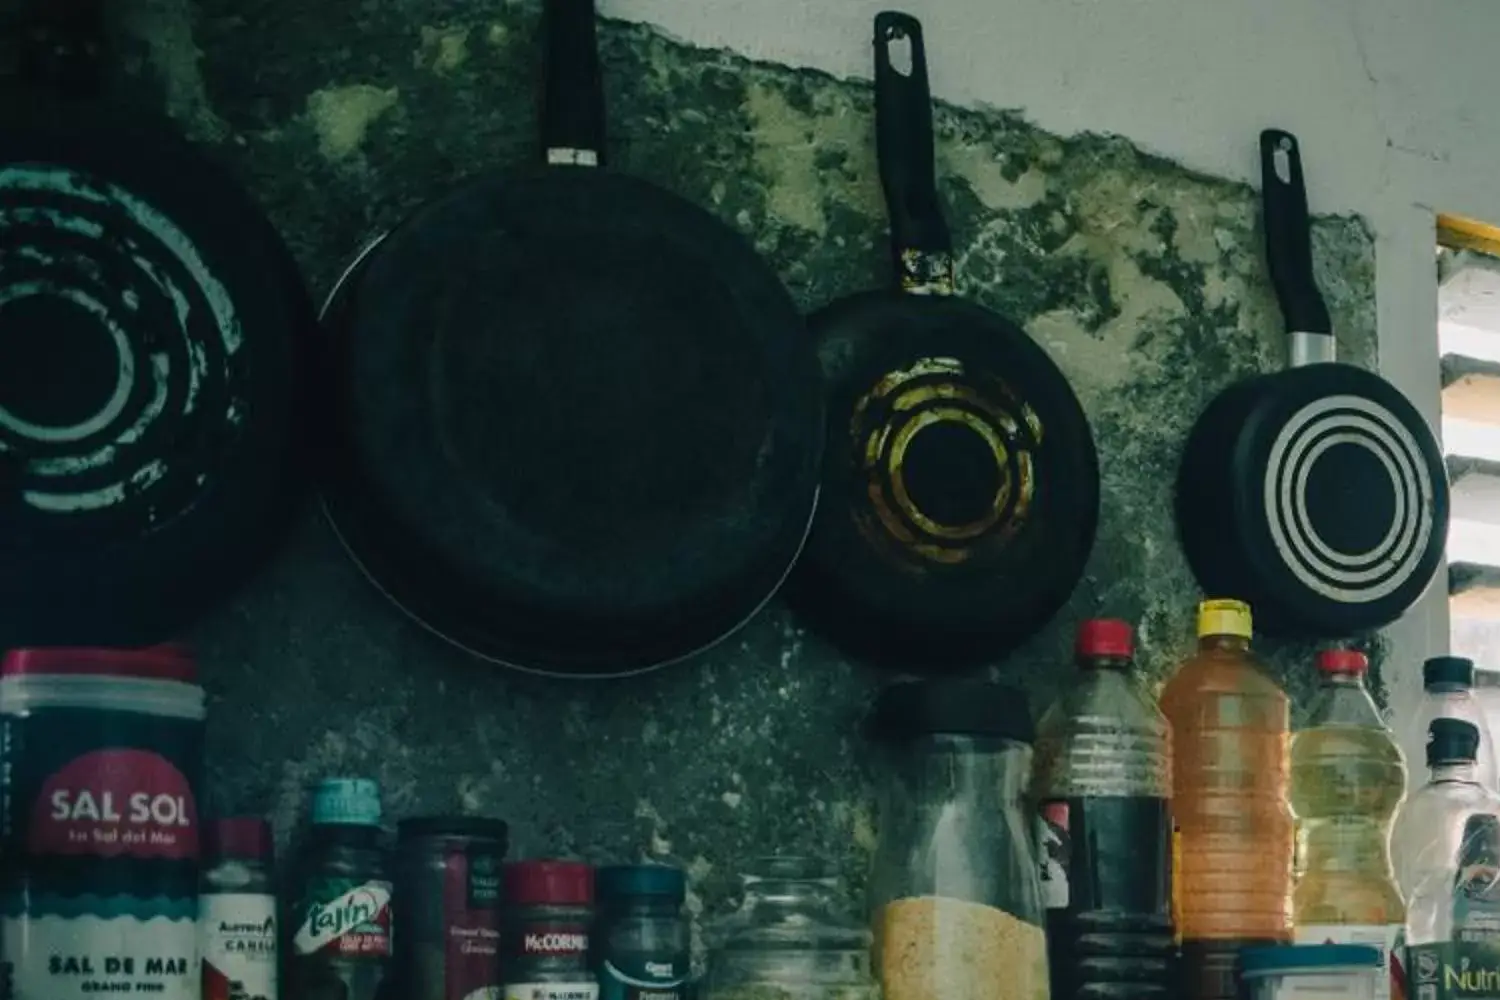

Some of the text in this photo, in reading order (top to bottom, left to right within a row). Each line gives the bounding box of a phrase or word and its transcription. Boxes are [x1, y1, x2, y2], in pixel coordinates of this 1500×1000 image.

[51, 789, 190, 826] SAL SOL
[48, 955, 188, 976] SAL DE MAR
